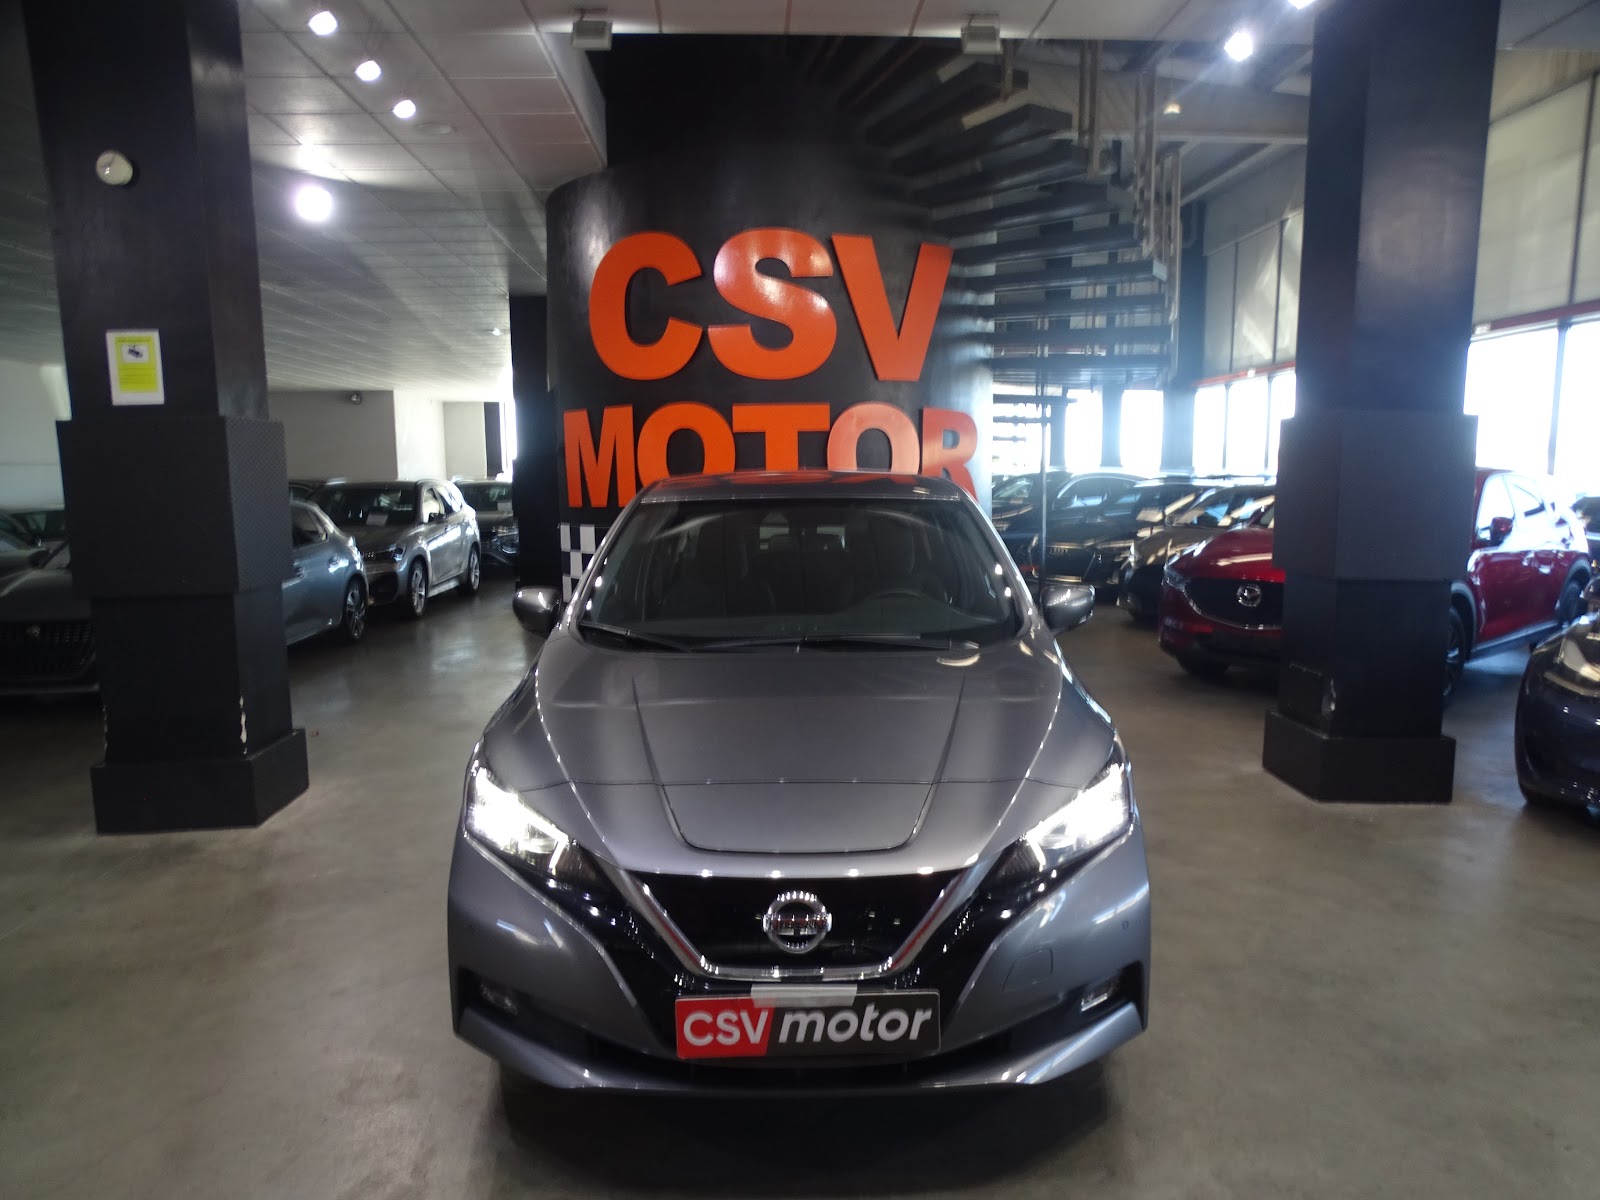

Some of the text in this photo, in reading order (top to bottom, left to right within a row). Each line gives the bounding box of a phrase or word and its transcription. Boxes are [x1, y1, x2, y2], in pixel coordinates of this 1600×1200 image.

[589, 228, 953, 381] CSV
[563, 402, 979, 508] MOTOR
[683, 1003, 932, 1046] CSV motor
